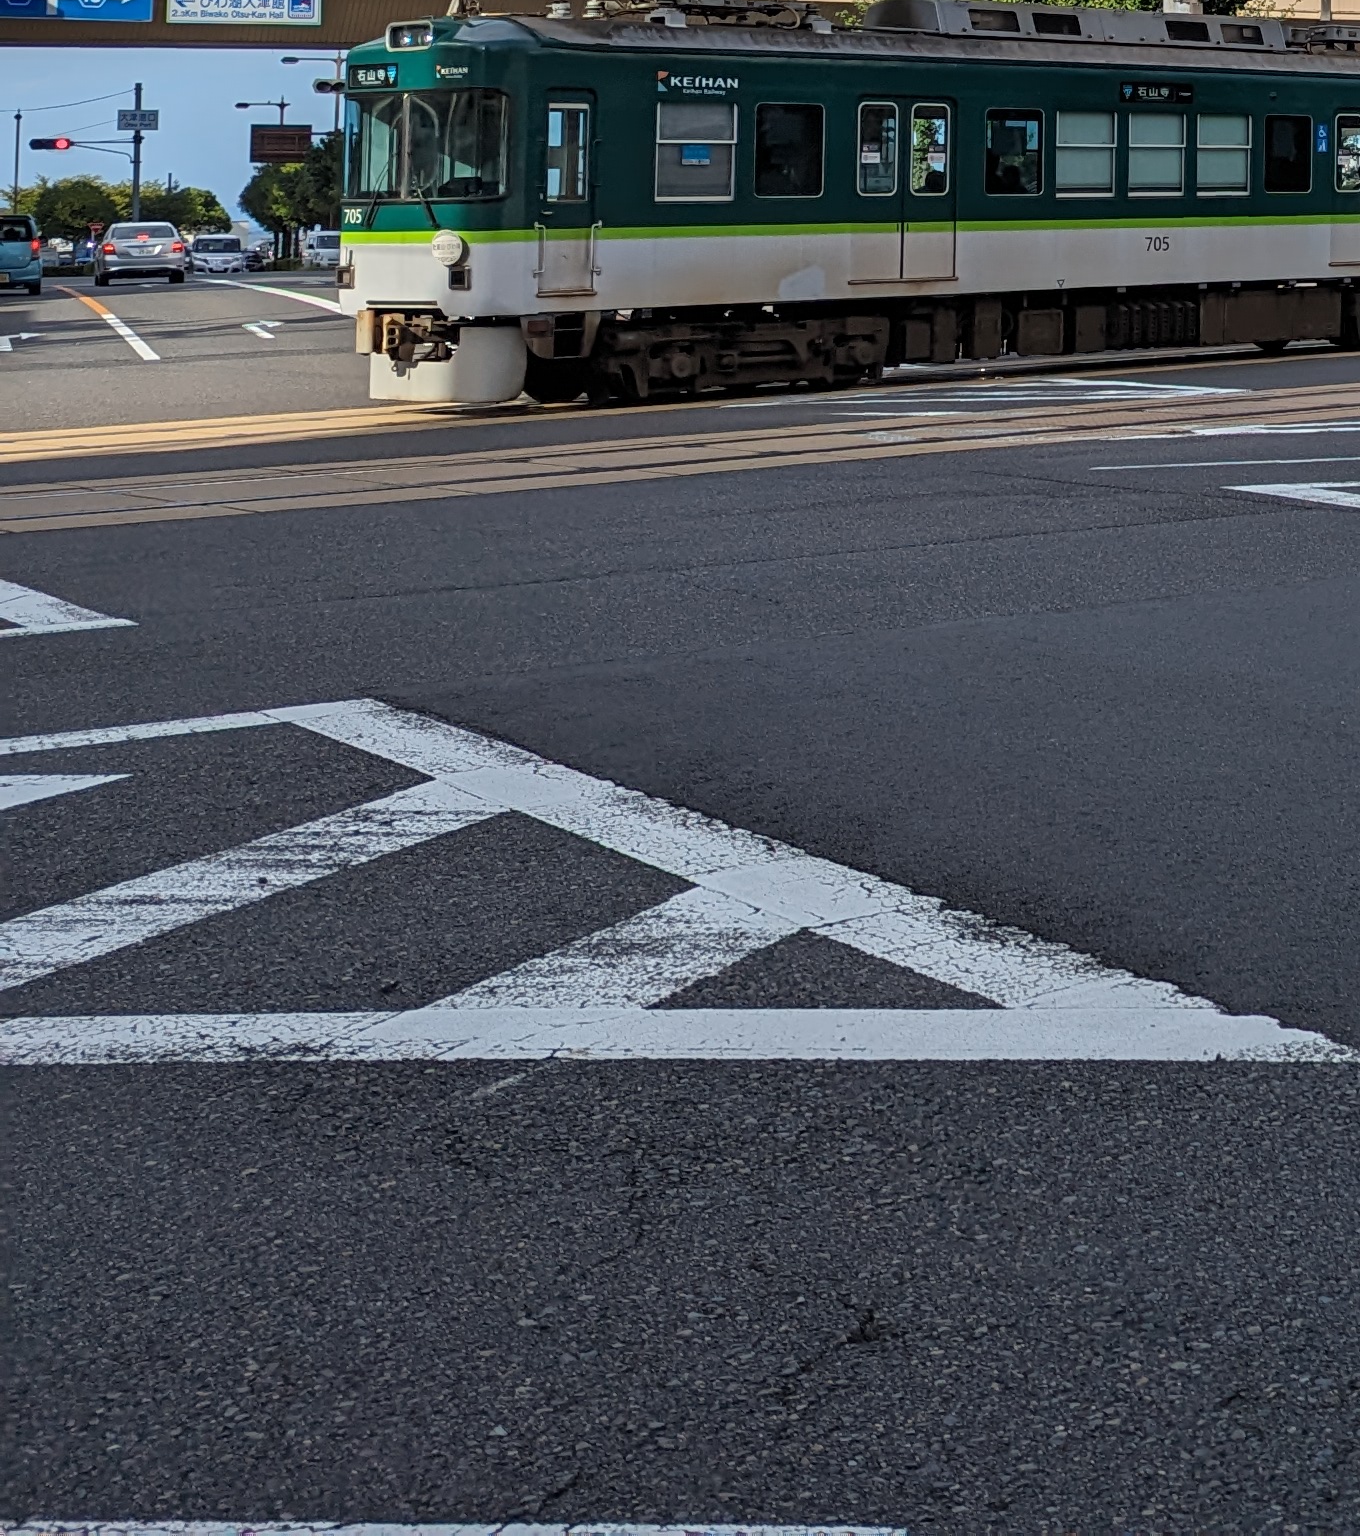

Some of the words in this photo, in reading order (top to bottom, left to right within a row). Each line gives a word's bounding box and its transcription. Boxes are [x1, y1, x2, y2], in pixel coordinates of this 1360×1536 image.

[200, 10, 229, 19] Biwako
[269, 11, 284, 19] Hall
[670, 76, 739, 89] KEIHAN
[343, 208, 362, 224] 705
[1144, 236, 1170, 252] 705
